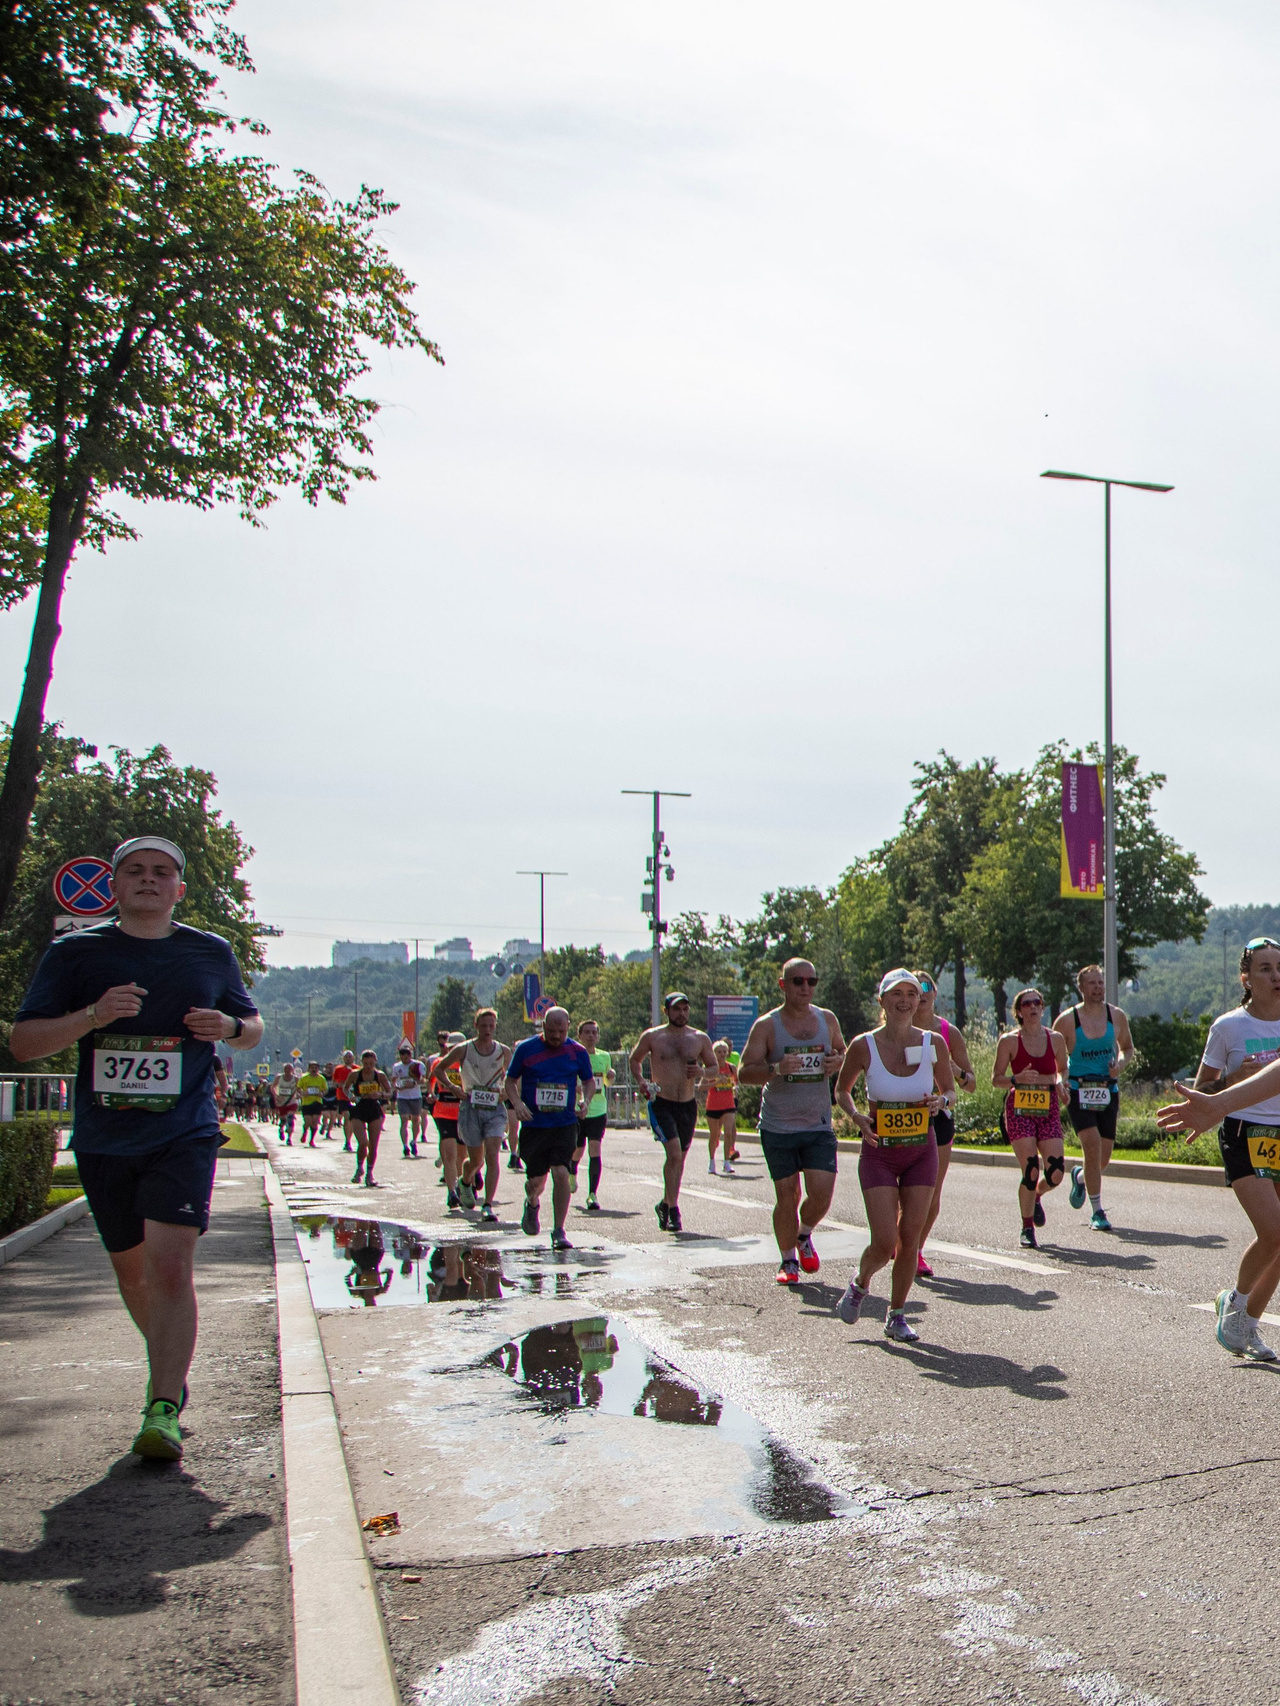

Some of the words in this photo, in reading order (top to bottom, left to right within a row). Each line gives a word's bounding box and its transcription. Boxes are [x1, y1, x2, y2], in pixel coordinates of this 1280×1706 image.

[1069, 767, 1078, 813] ФИТНЕС
[104, 1056, 170, 1081] 3763
[101, 1094, 111, 1106] E
[474, 1091, 495, 1102] 5496
[541, 1091, 564, 1101] 1715
[1020, 1092, 1046, 1103] 7193
[1083, 1090, 1107, 1099] 2726
[884, 1112, 923, 1128] 3830
